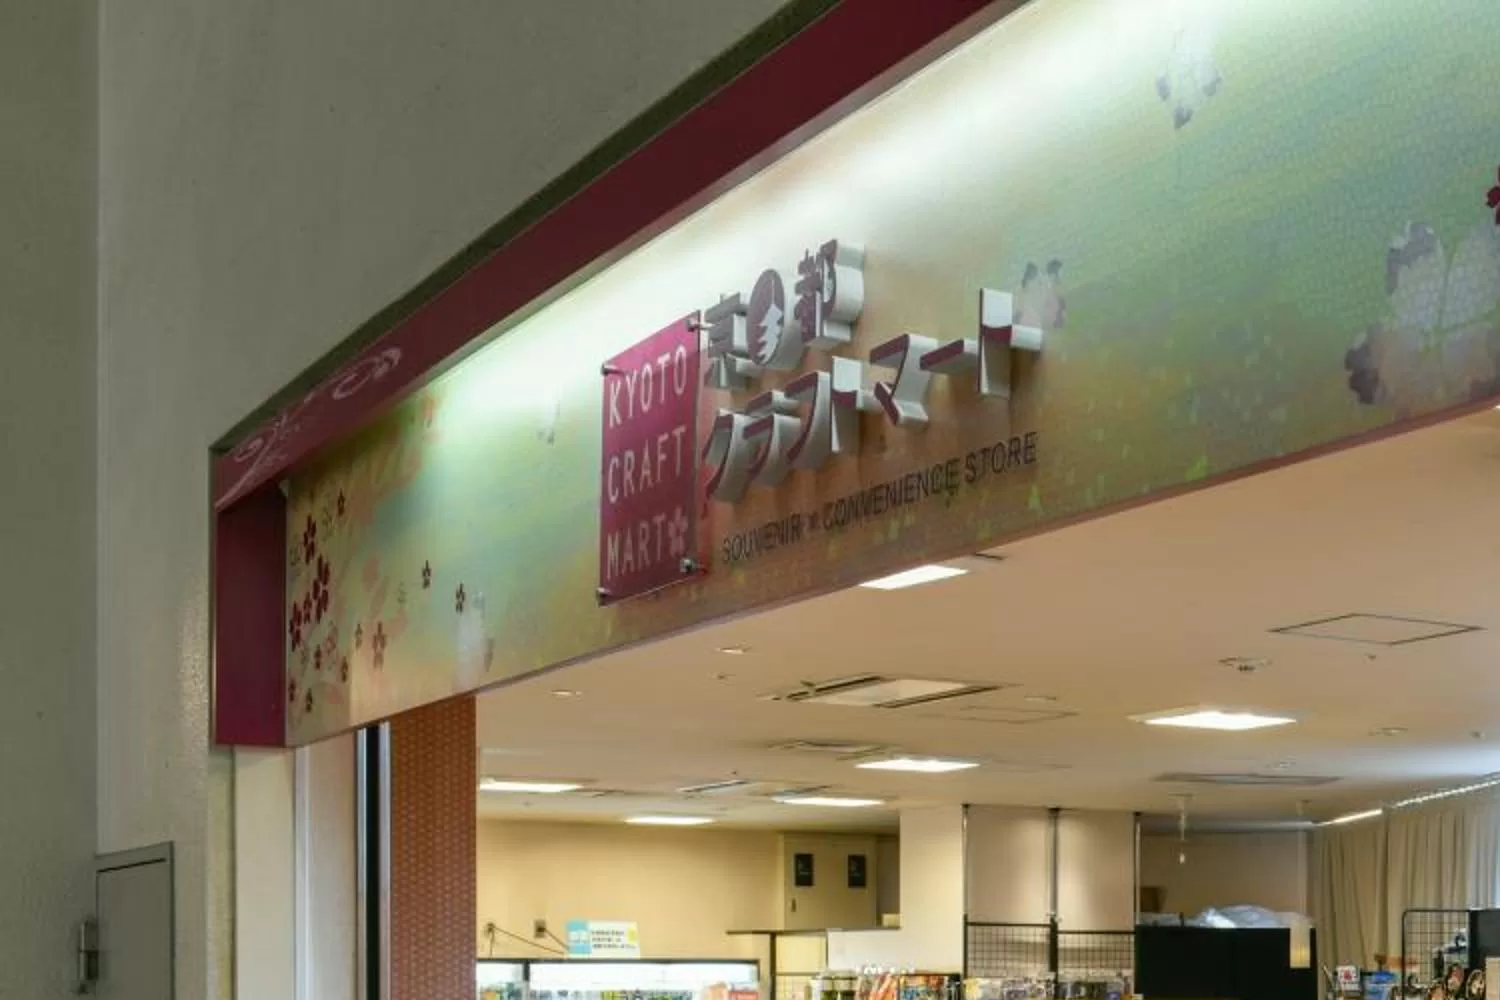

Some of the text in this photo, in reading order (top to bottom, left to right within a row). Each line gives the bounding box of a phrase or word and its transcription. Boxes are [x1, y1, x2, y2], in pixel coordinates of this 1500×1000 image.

[609, 344, 687, 429] KYOTO
[701, 287, 1030, 500] クラフトマート
[607, 425, 687, 504] CRAFT
[722, 513, 802, 564] SOUVENIR
[823, 458, 961, 532] CONVENIENCE
[963, 431, 1038, 484] STORE
[606, 511, 667, 580] MART
